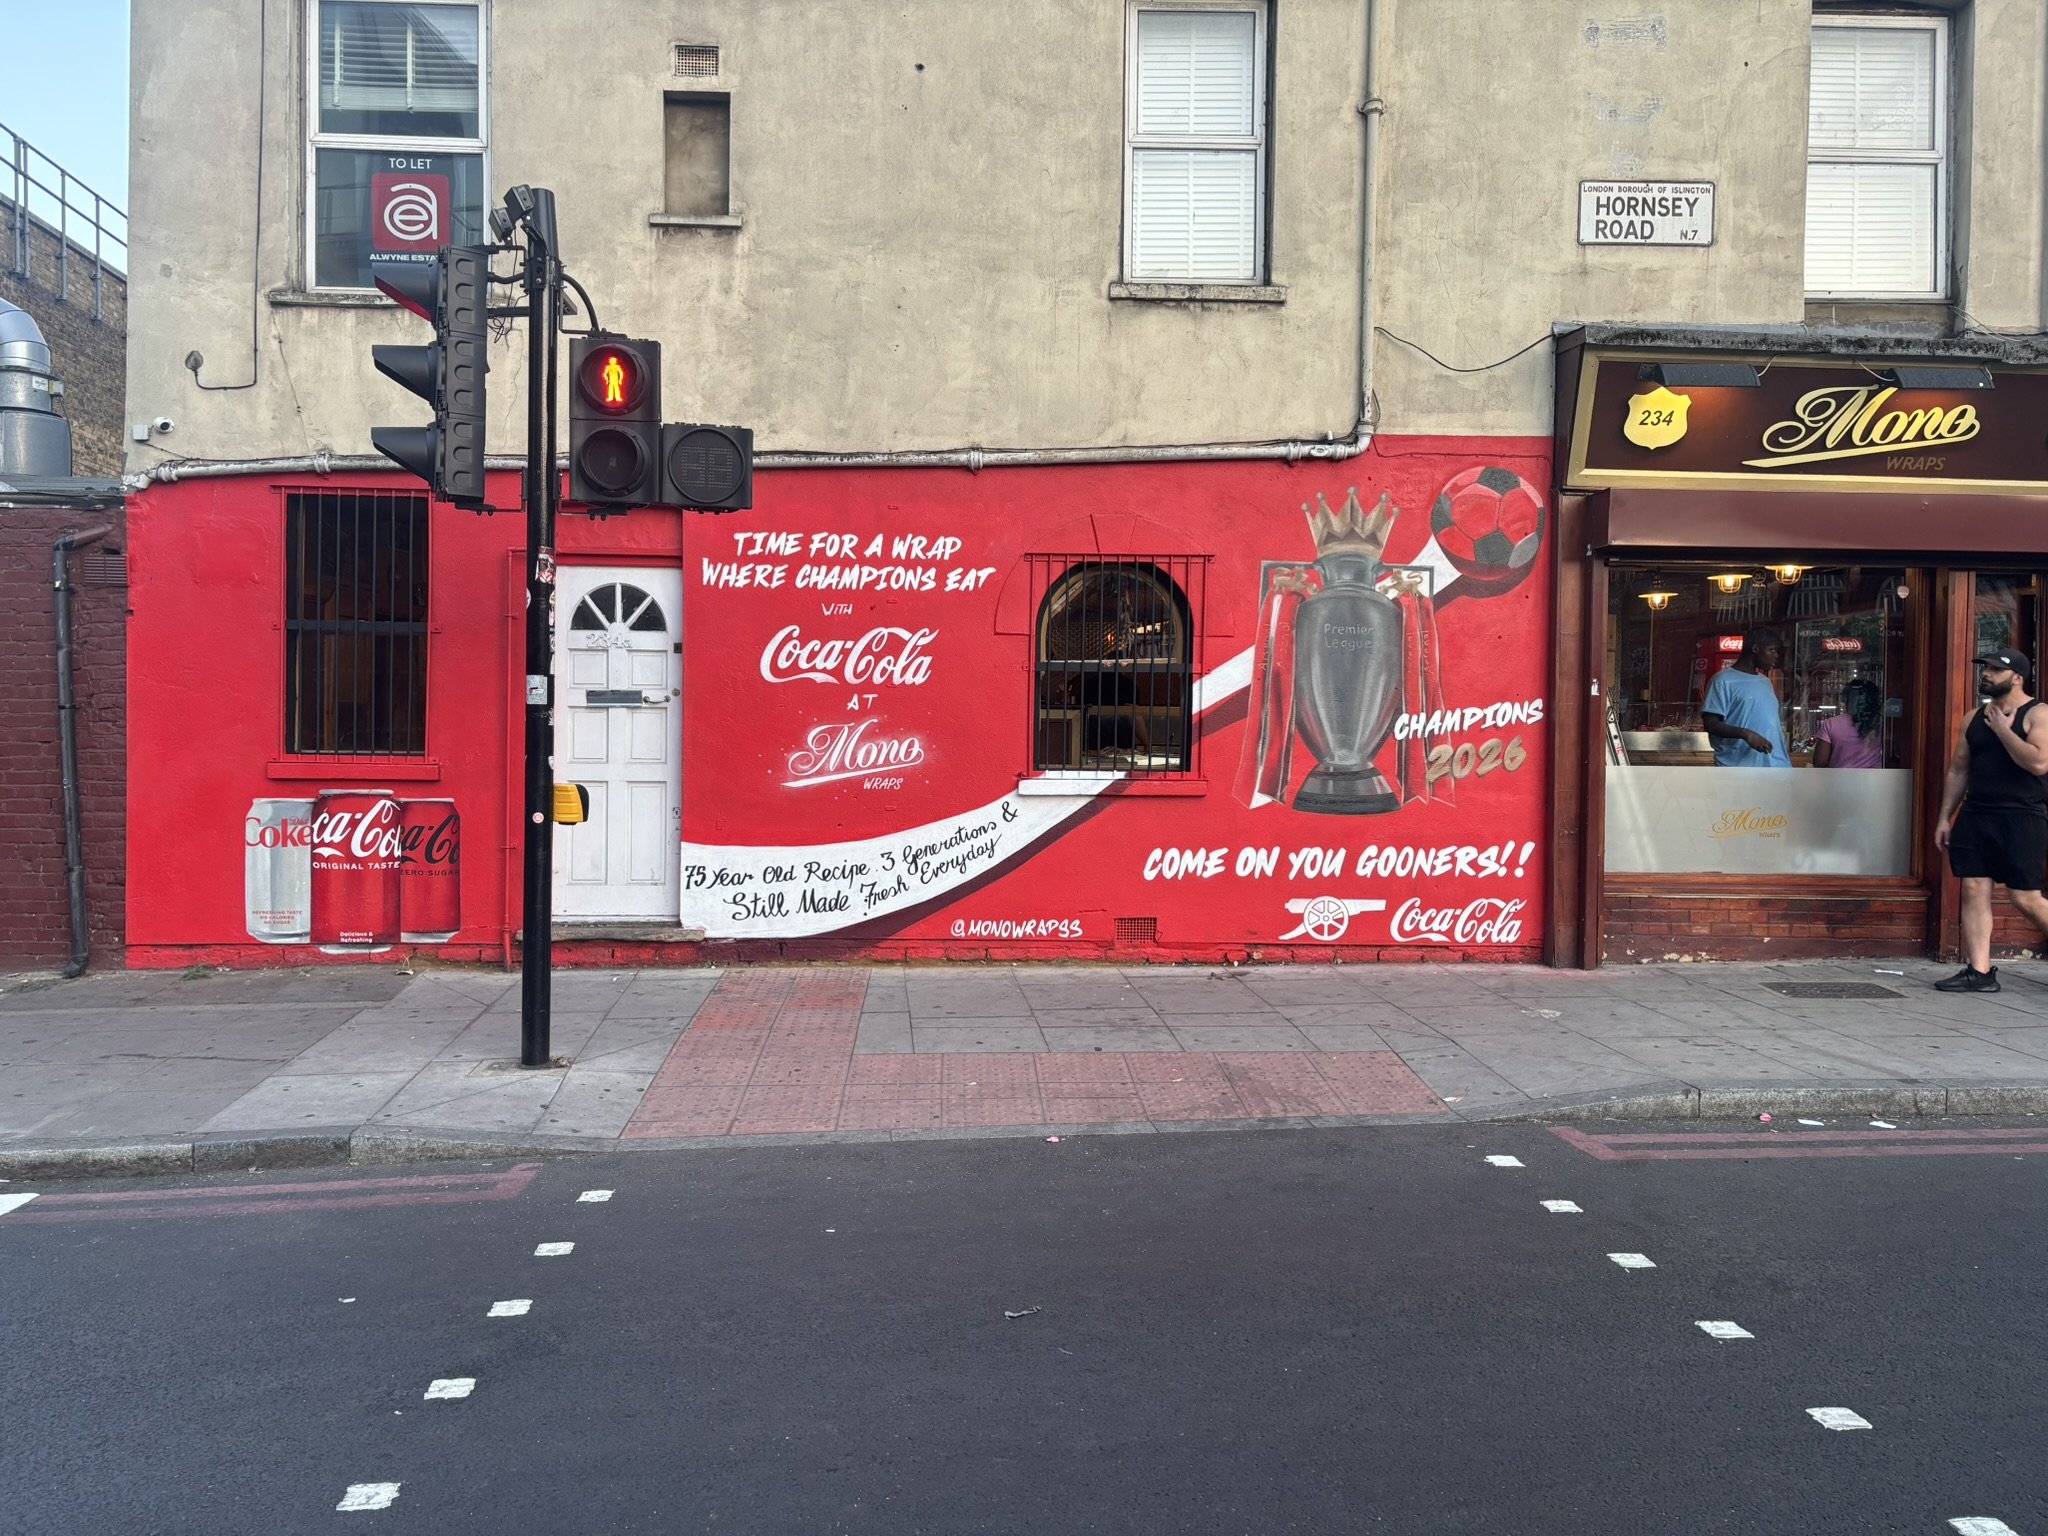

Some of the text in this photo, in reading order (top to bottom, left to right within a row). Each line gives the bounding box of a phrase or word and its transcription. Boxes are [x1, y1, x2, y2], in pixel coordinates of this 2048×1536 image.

[388, 158, 432, 170] TO LET
[1583, 185, 1711, 194] LONDON BOROUGH OF ISLINGTON
[1595, 196, 1700, 217] HORNSEY
[1595, 219, 1698, 241] ROAD N.7
[411, 254, 438, 262] ESTA
[1638, 409, 1675, 428] 234
[1762, 384, 1981, 453] Mono
[1886, 456, 1946, 471] WRAPS
[734, 532, 963, 560] TIME FOR A WRAP
[702, 557, 997, 592] WHERE CHAMPIONS EAT
[1323, 623, 1375, 636] Premier
[1324, 637, 1374, 650] League
[760, 624, 940, 686] Coca-Cola
[847, 694, 878, 710] AT
[1394, 698, 1544, 741] CHAMPIONS
[788, 718, 925, 777] Mono
[1426, 735, 1527, 784] 2026
[863, 777, 904, 790] WRAPS
[246, 817, 314, 849] Coke
[685, 865, 707, 890] 75
[706, 868, 755, 889] Year
[763, 865, 797, 884] Old
[880, 851, 895, 871] 3
[902, 821, 997, 875] Generations
[1001, 801, 1018, 822] &
[312, 861, 401, 870] ORIGINAL TASTE
[1143, 840, 1536, 881] COME ON YOU GOONERS!!
[400, 869, 424, 877] ZERO
[722, 833, 1003, 921] Still Made Fresh Everyday
[950, 917, 1083, 939] @MONOWRAPSS
[1389, 896, 1528, 944] Coca-Cola
